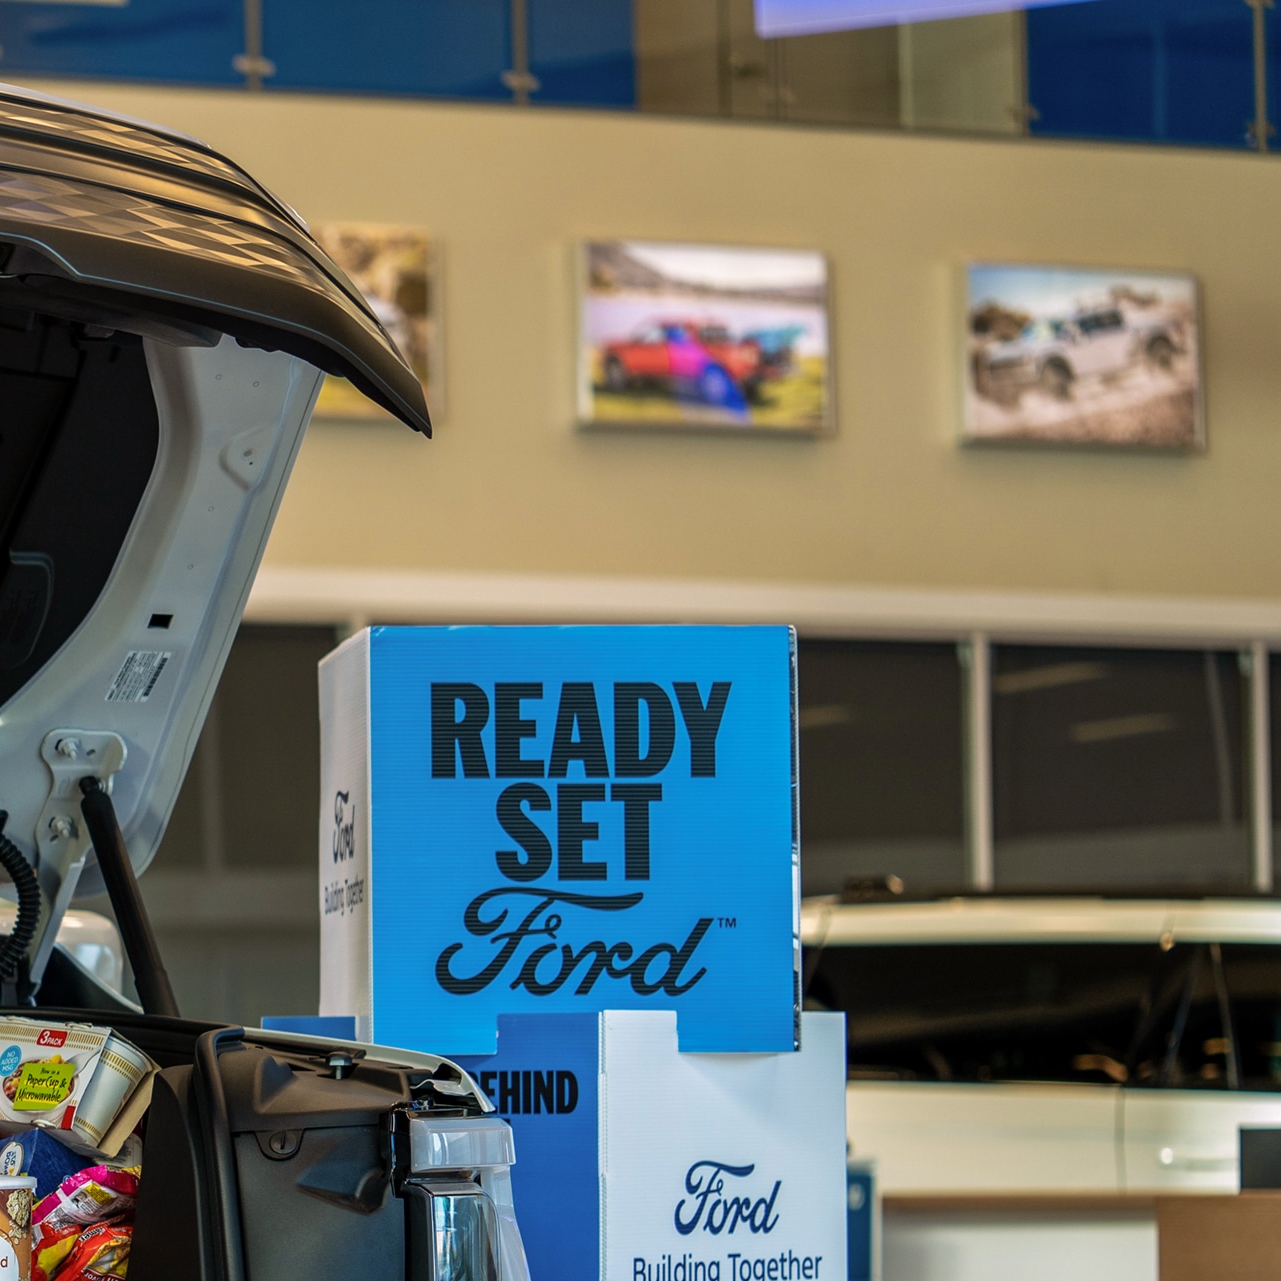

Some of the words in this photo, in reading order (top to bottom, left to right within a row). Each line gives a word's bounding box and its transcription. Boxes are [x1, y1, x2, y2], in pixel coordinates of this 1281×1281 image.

[430, 682, 731, 779] READY
[333, 790, 356, 864] Ford
[495, 782, 662, 881] SET
[324, 881, 344, 916] Building
[345, 875, 364, 914] Together
[435, 887, 715, 997] Ford
[16, 1088, 61, 1102] Microwavable
[674, 1160, 782, 1235] Ford
